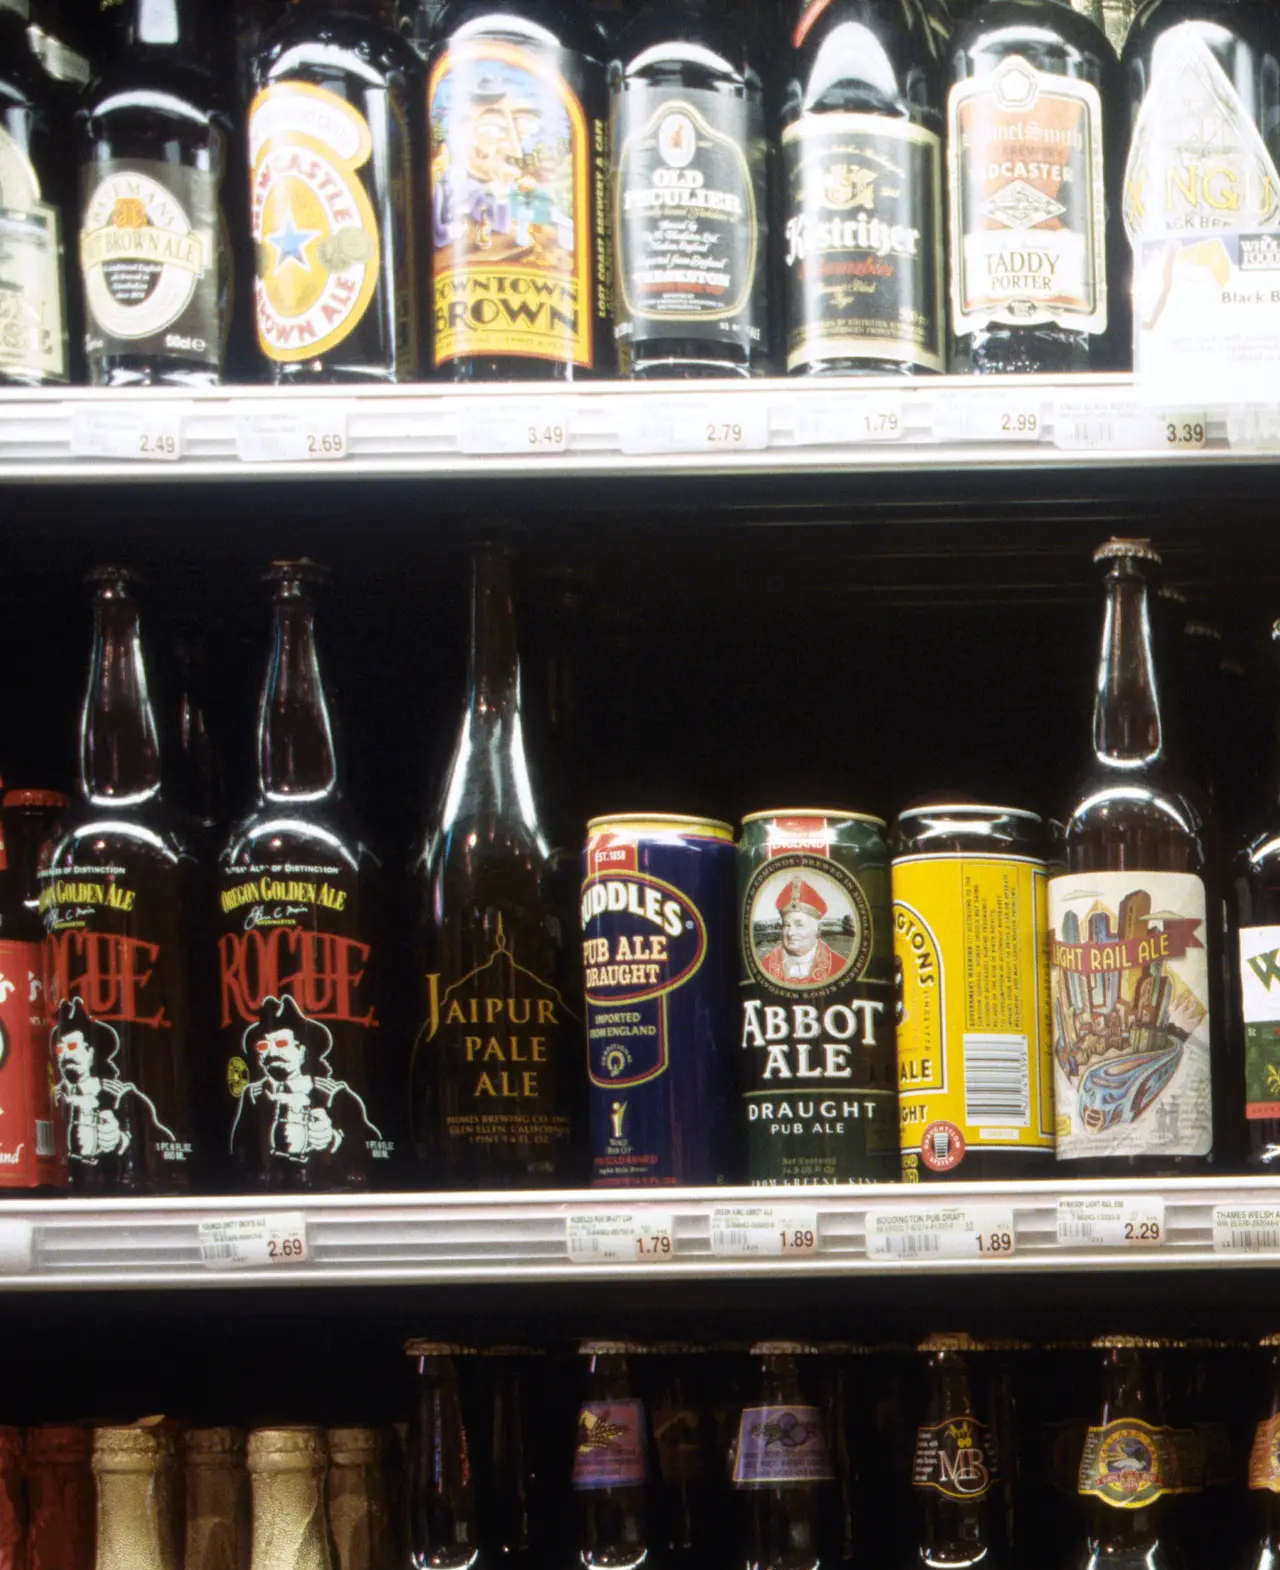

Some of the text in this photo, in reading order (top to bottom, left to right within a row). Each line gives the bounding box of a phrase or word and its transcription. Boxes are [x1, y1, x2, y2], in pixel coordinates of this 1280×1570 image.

[990, 273, 1052, 291] PORTER
[1221, 290, 1273, 303] Black
[1002, 414, 1037, 431] 2.99
[308, 434, 343, 451] 2.69
[528, 425, 563, 444] 3.49
[707, 424, 742, 442] 2.79
[140, 435, 176, 453] 2.49
[583, 936, 668, 964] PUB ALE
[1051, 933, 1170, 971] LIGHT RAIL ALE
[218, 928, 380, 1027] ROGUE
[585, 964, 660, 986] DRAUGHT
[425, 972, 559, 1041] JAIPUR
[742, 998, 885, 1042] ABBOT
[465, 1037, 548, 1063] PALE
[762, 1044, 852, 1080] ALE
[472, 1071, 539, 1098] ALE
[748, 1102, 877, 1121] DRAUGHT
[771, 1123, 845, 1134] PUB ALE
[1216, 1210, 1245, 1220] THAMES
[1247, 1210, 1273, 1219] WELSH
[780, 1231, 814, 1249] 1.89
[1124, 1222, 1160, 1240] 2.29
[267, 1239, 302, 1259] 2.69
